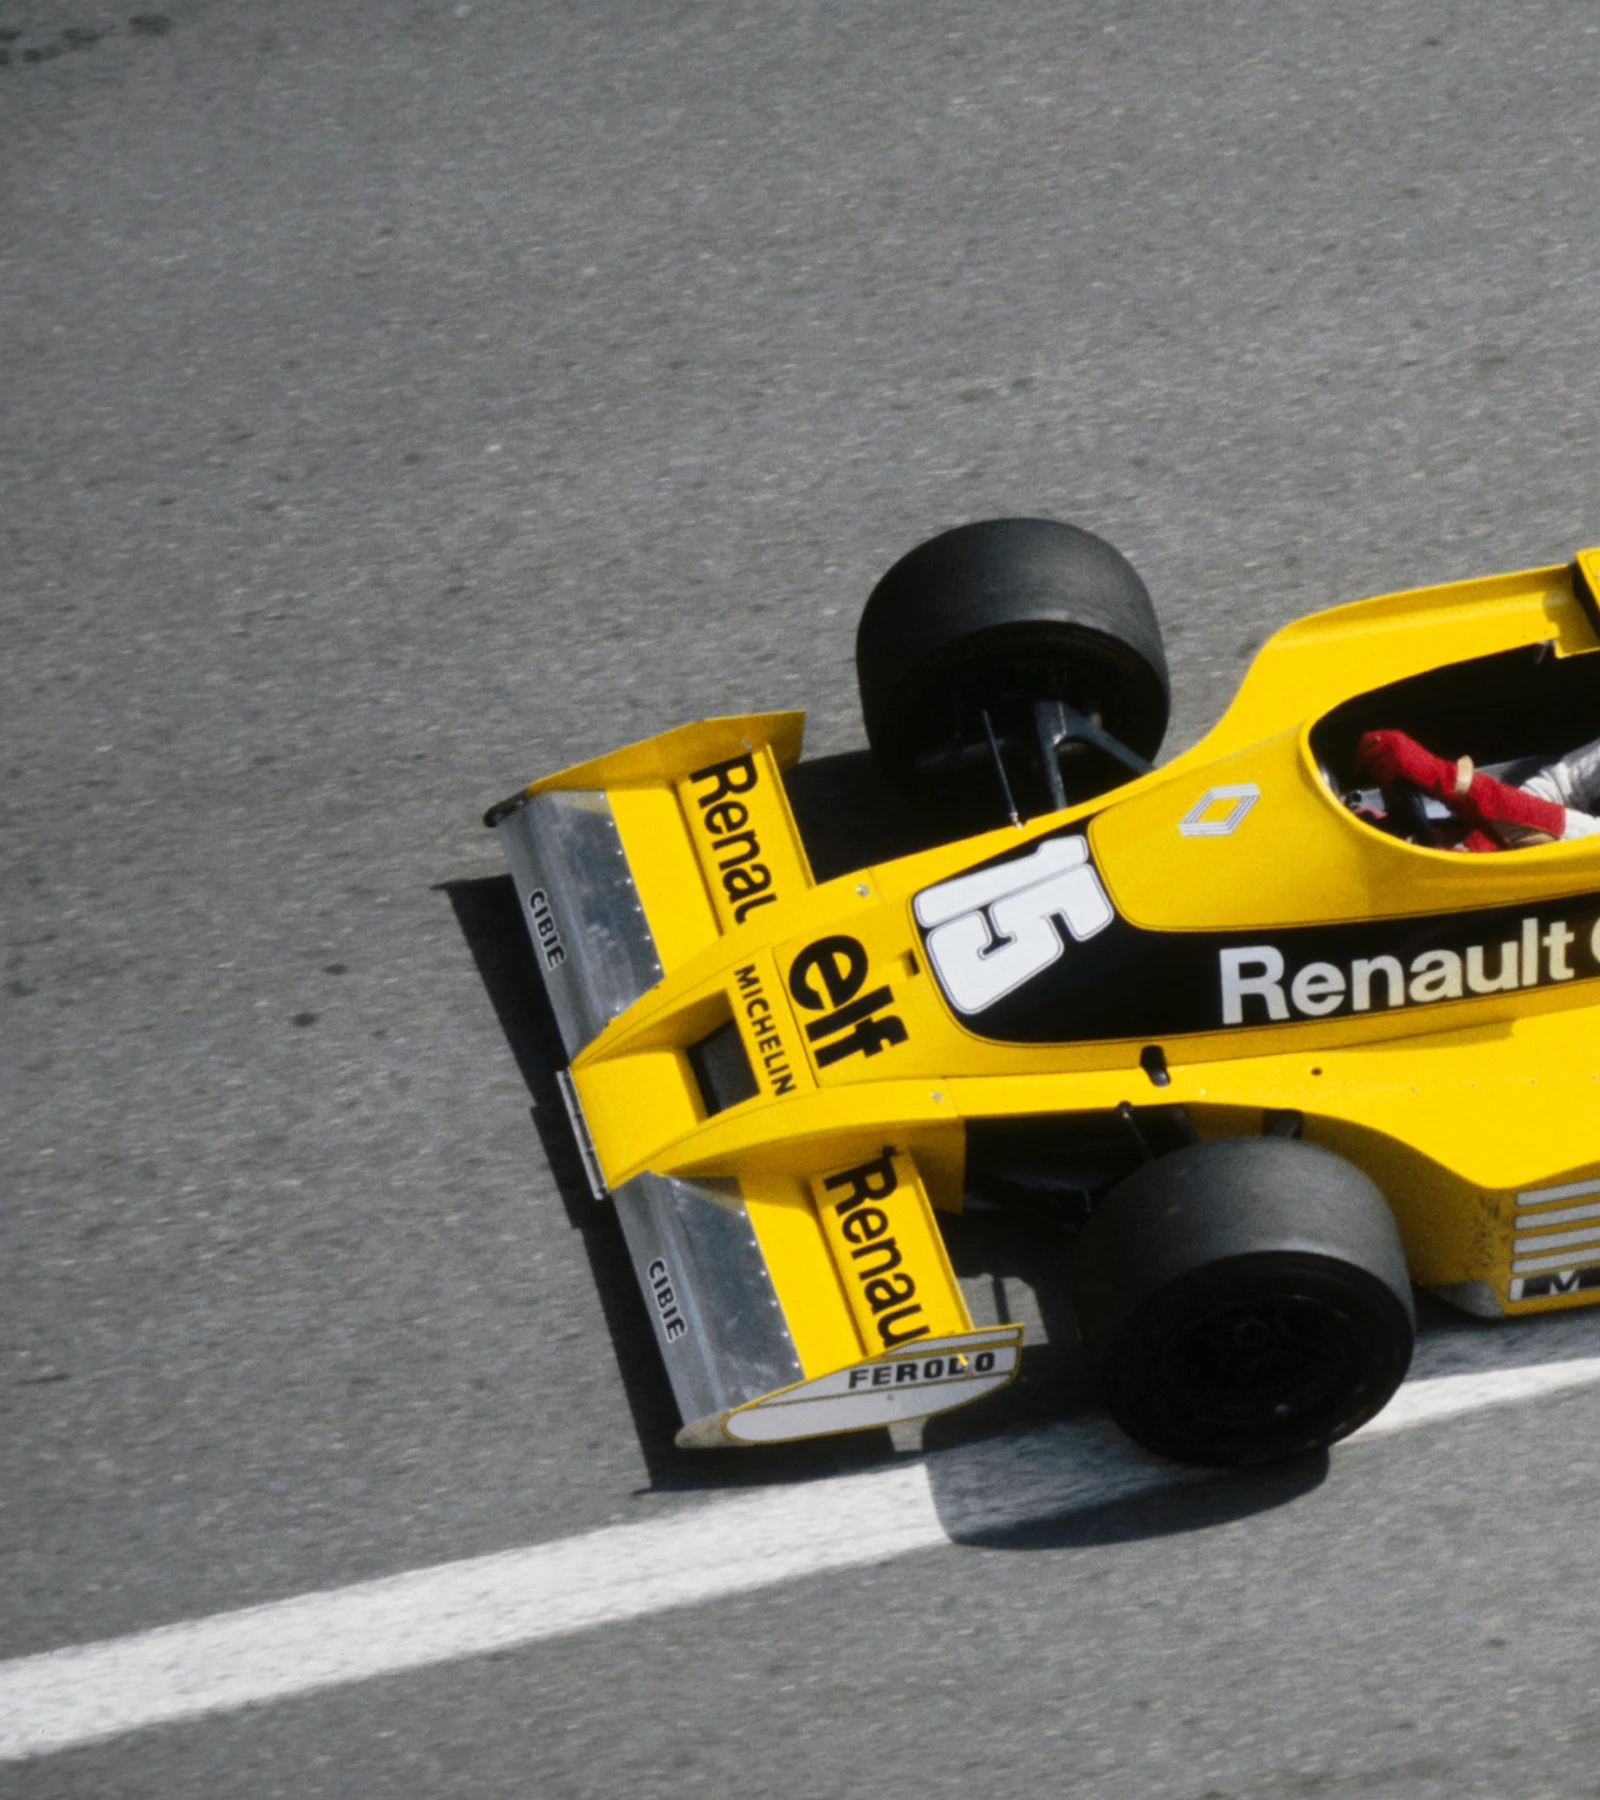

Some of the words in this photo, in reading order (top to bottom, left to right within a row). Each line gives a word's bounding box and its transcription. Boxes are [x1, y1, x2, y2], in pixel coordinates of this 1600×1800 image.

[530, 890, 565, 968] CIBIE
[914, 834, 1114, 1014] 15
[1218, 918, 1575, 1025] Renault
[734, 963, 797, 1097] MICHELIN
[788, 934, 909, 1070] elf
[649, 1260, 686, 1340] CIBIE
